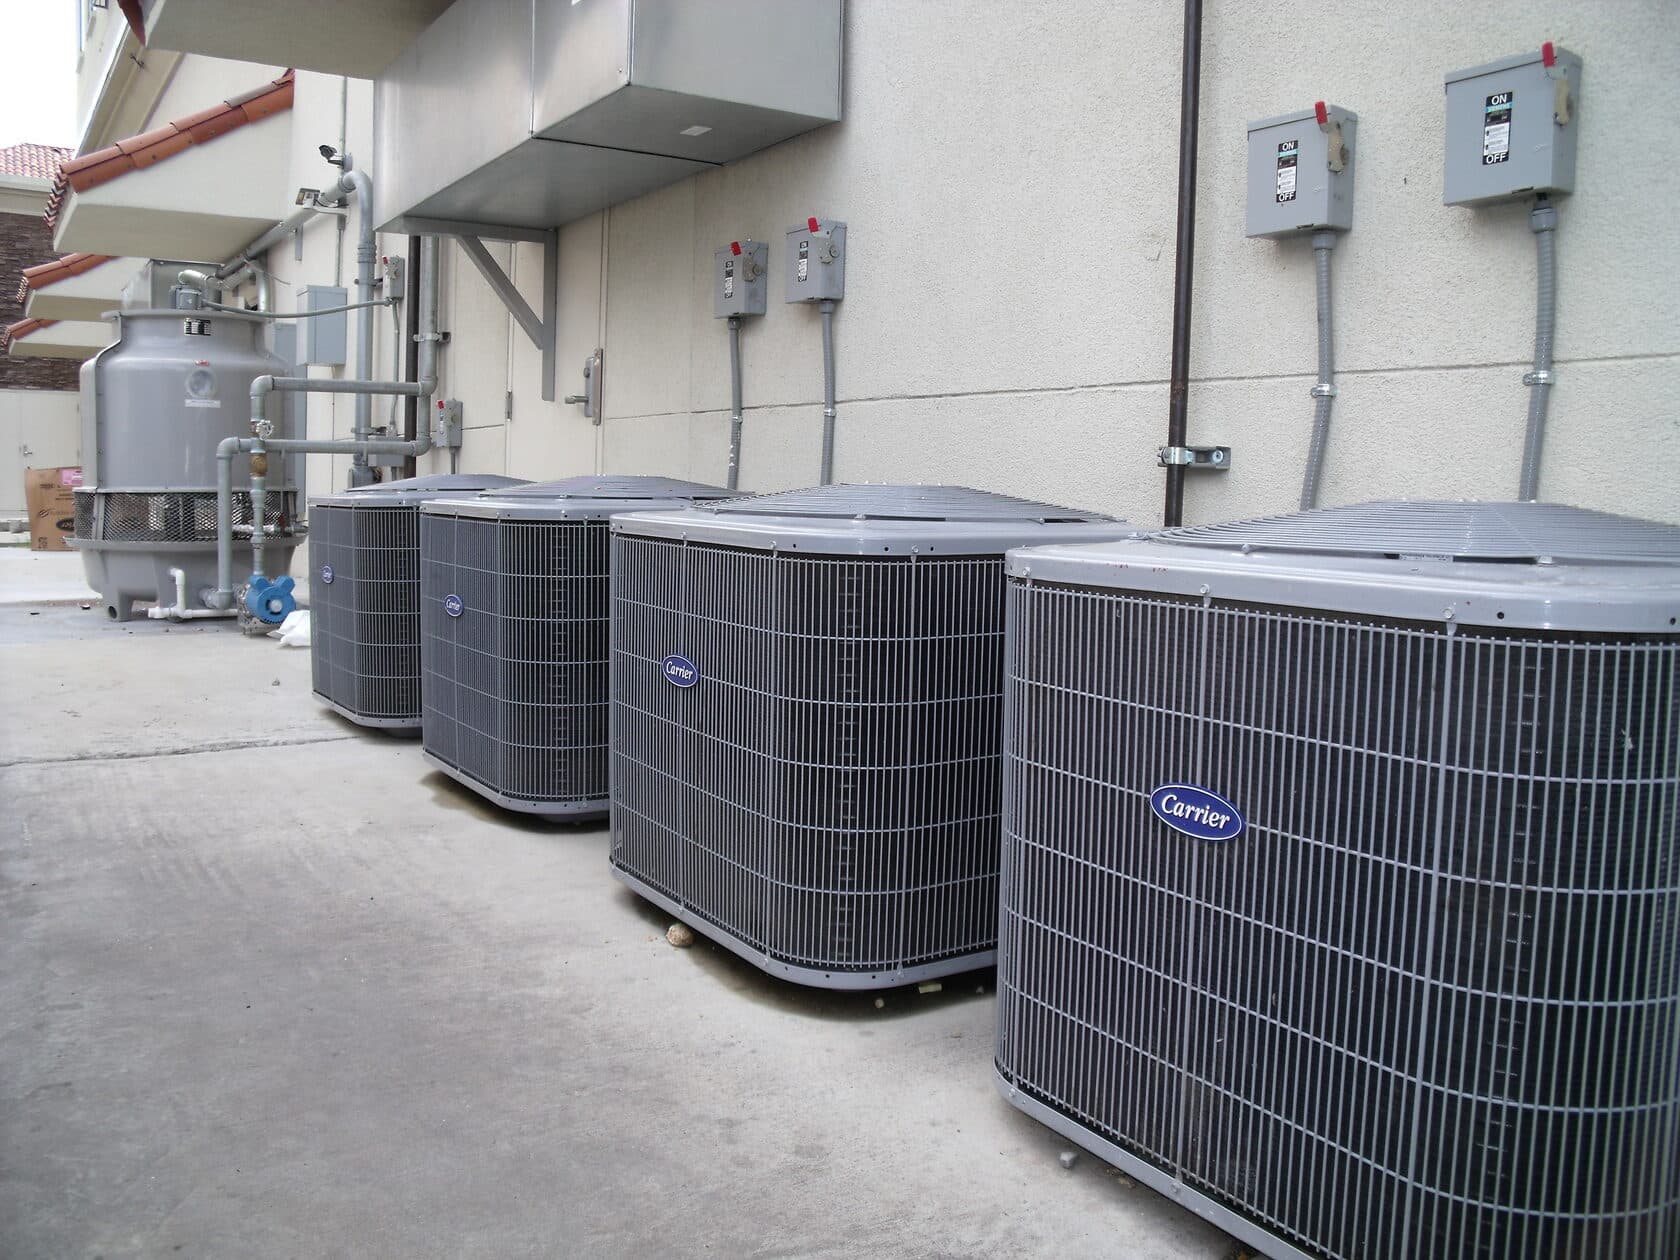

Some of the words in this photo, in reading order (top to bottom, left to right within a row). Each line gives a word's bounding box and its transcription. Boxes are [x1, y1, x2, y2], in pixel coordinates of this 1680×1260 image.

[1491, 94, 1507, 105] ON
[1282, 141, 1294, 151] ON
[1486, 153, 1507, 164] OFF
[1279, 191, 1294, 202] OFF
[666, 661, 693, 681] Carrier
[1161, 794, 1231, 829] Carrier
